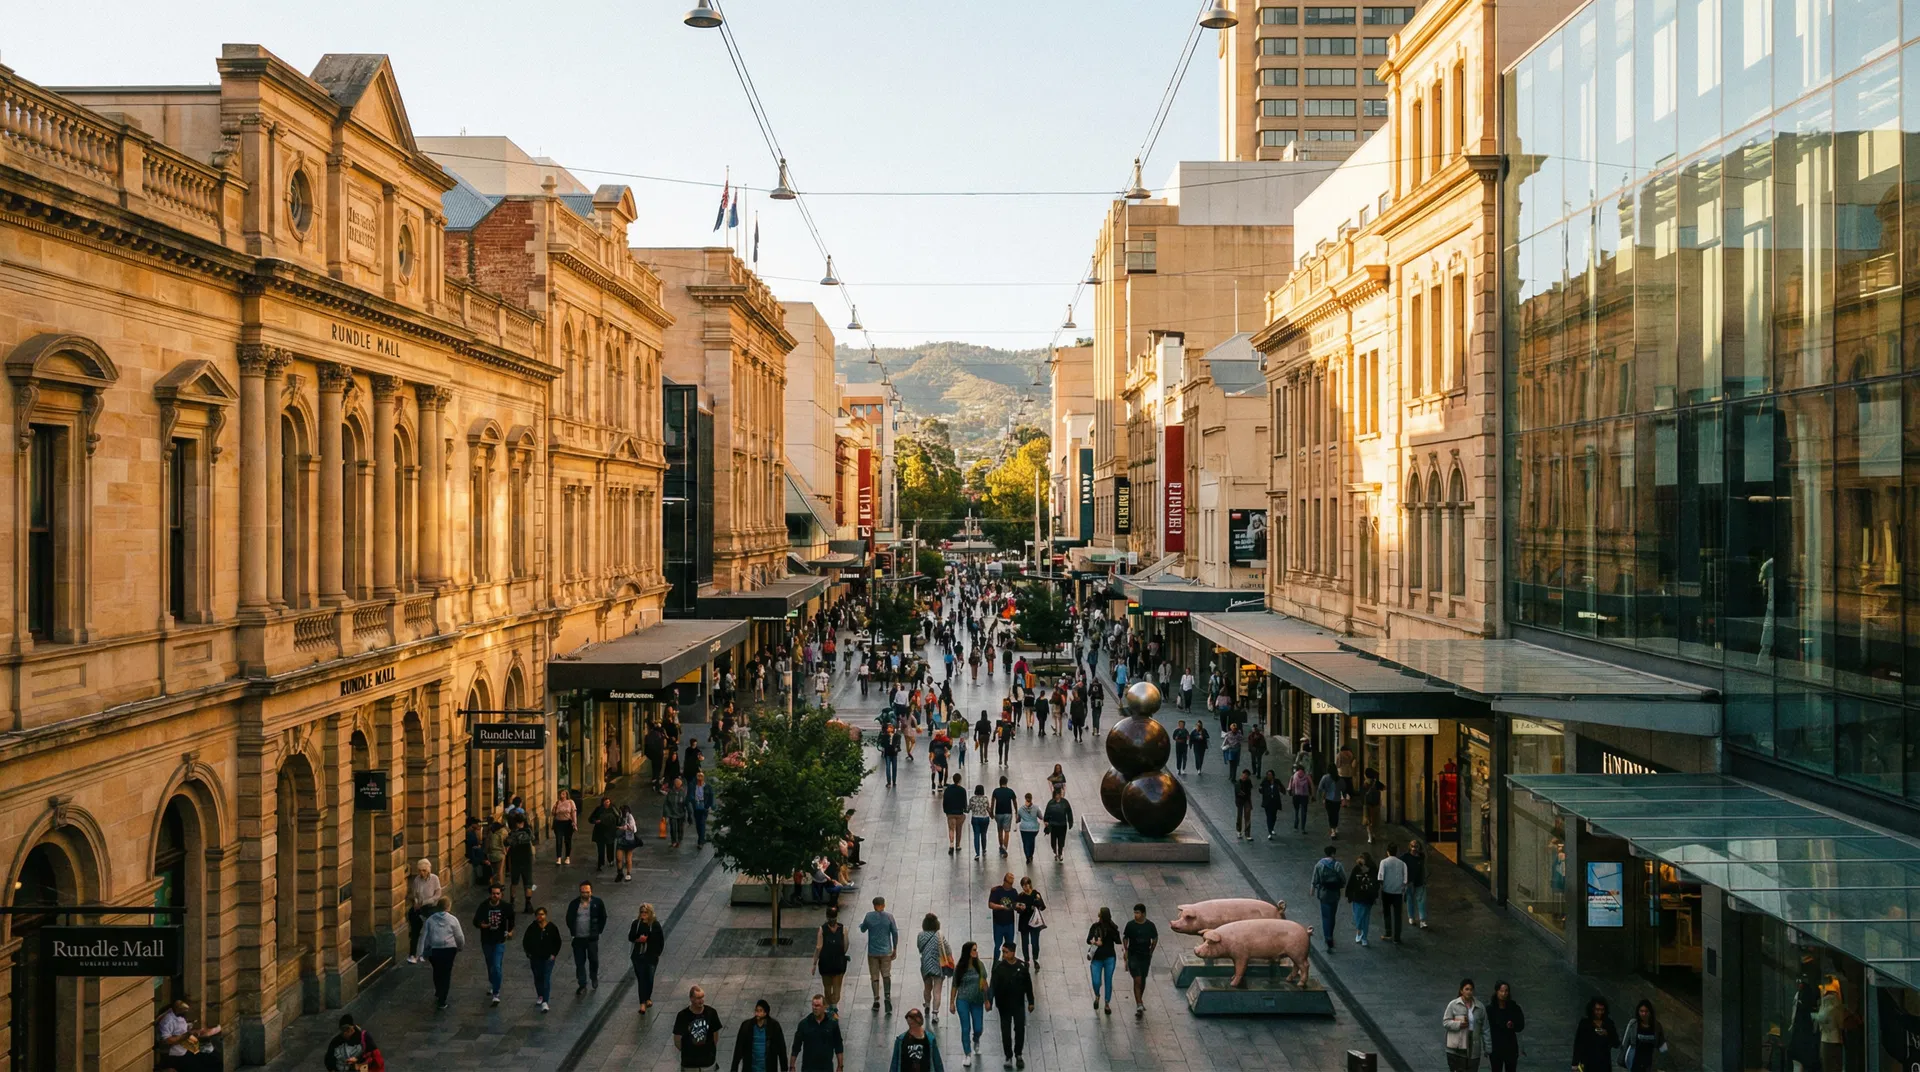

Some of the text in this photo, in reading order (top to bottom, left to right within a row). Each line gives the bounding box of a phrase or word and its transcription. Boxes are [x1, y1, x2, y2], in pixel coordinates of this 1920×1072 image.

[332, 323, 400, 358] RUNDLE MALL
[340, 667, 396, 696] RUNDLE MALL
[480, 729, 536, 740] Rundle Mall
[1409, 722, 1433, 730] MALL
[52, 939, 165, 957] Rundle Mall
